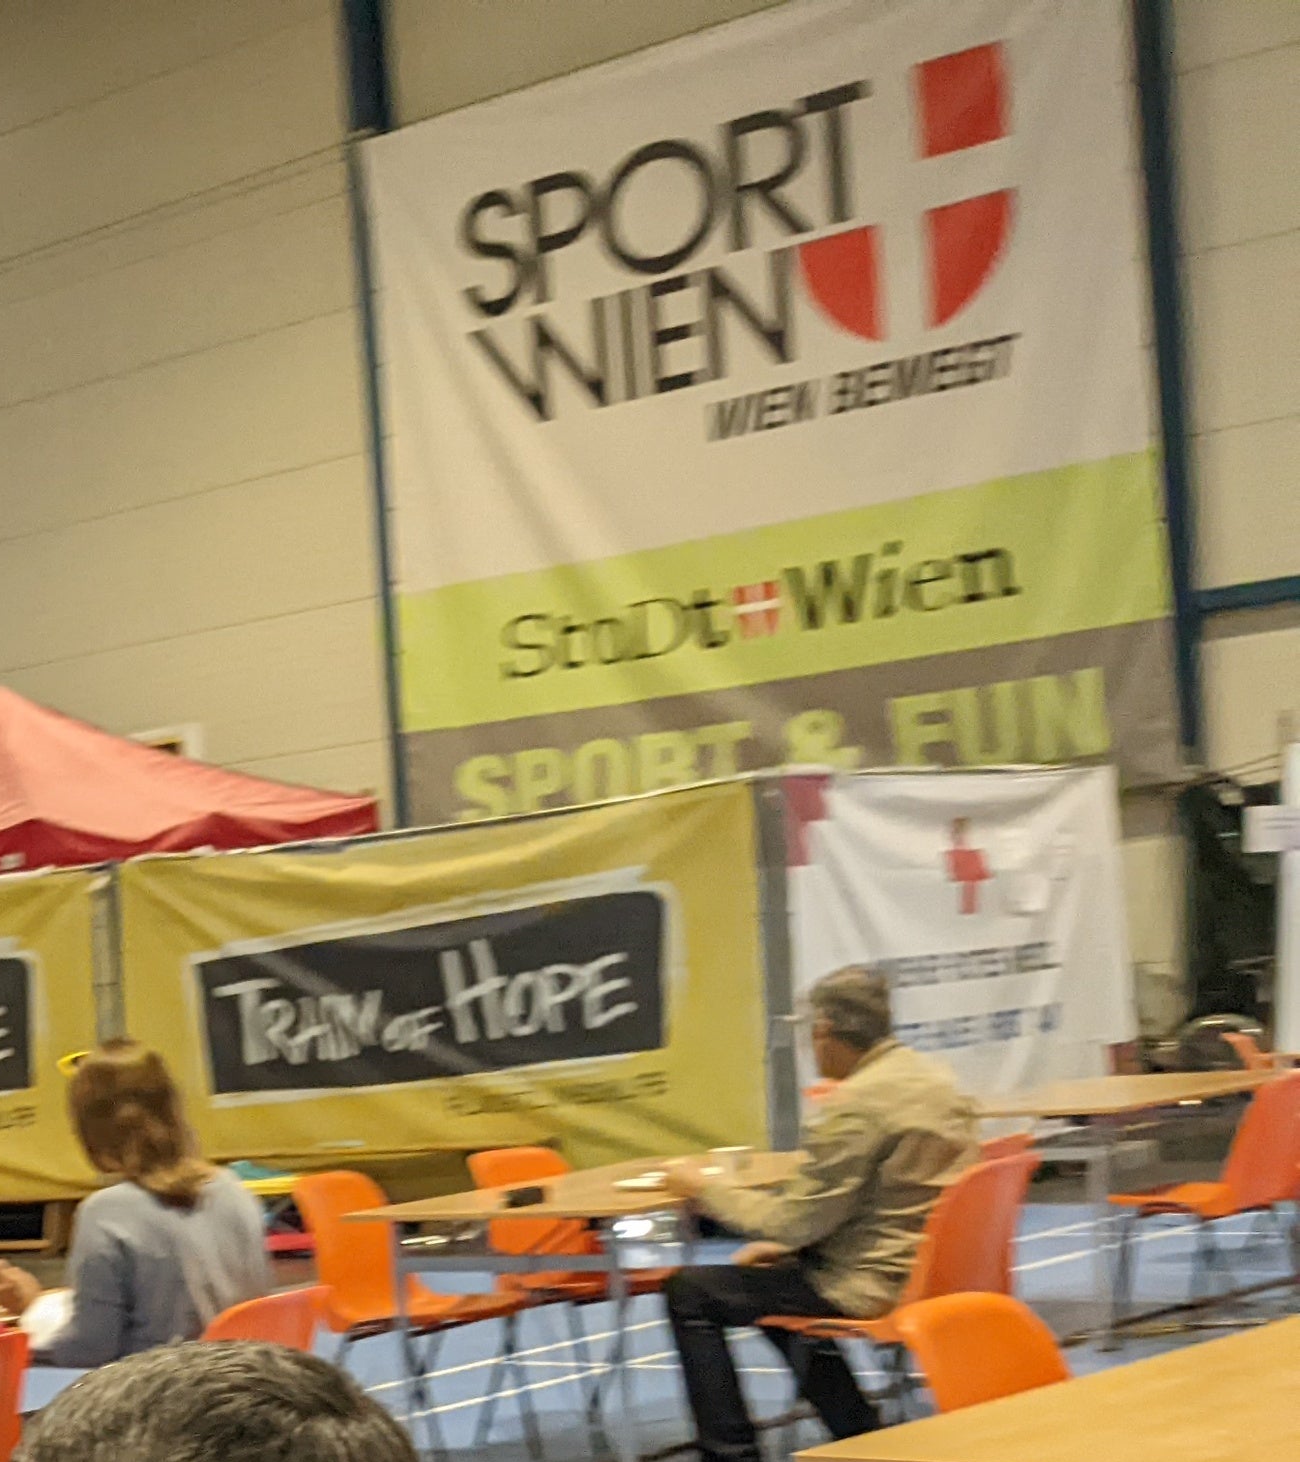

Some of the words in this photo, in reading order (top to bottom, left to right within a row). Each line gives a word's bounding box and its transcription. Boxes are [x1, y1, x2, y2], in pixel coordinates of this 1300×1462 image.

[457, 79, 872, 318] SPORT
[466, 247, 797, 422] WIEN
[705, 379, 824, 442] WIEN
[829, 332, 1023, 415] BEWEGT
[782, 540, 1023, 633] Wien
[456, 720, 751, 820] SPORT
[782, 709, 863, 770] &
[888, 665, 1111, 767] FUN
[212, 977, 384, 1066] TRAIN
[381, 1005, 445, 1053] OF
[439, 938, 639, 1044] HOPE
